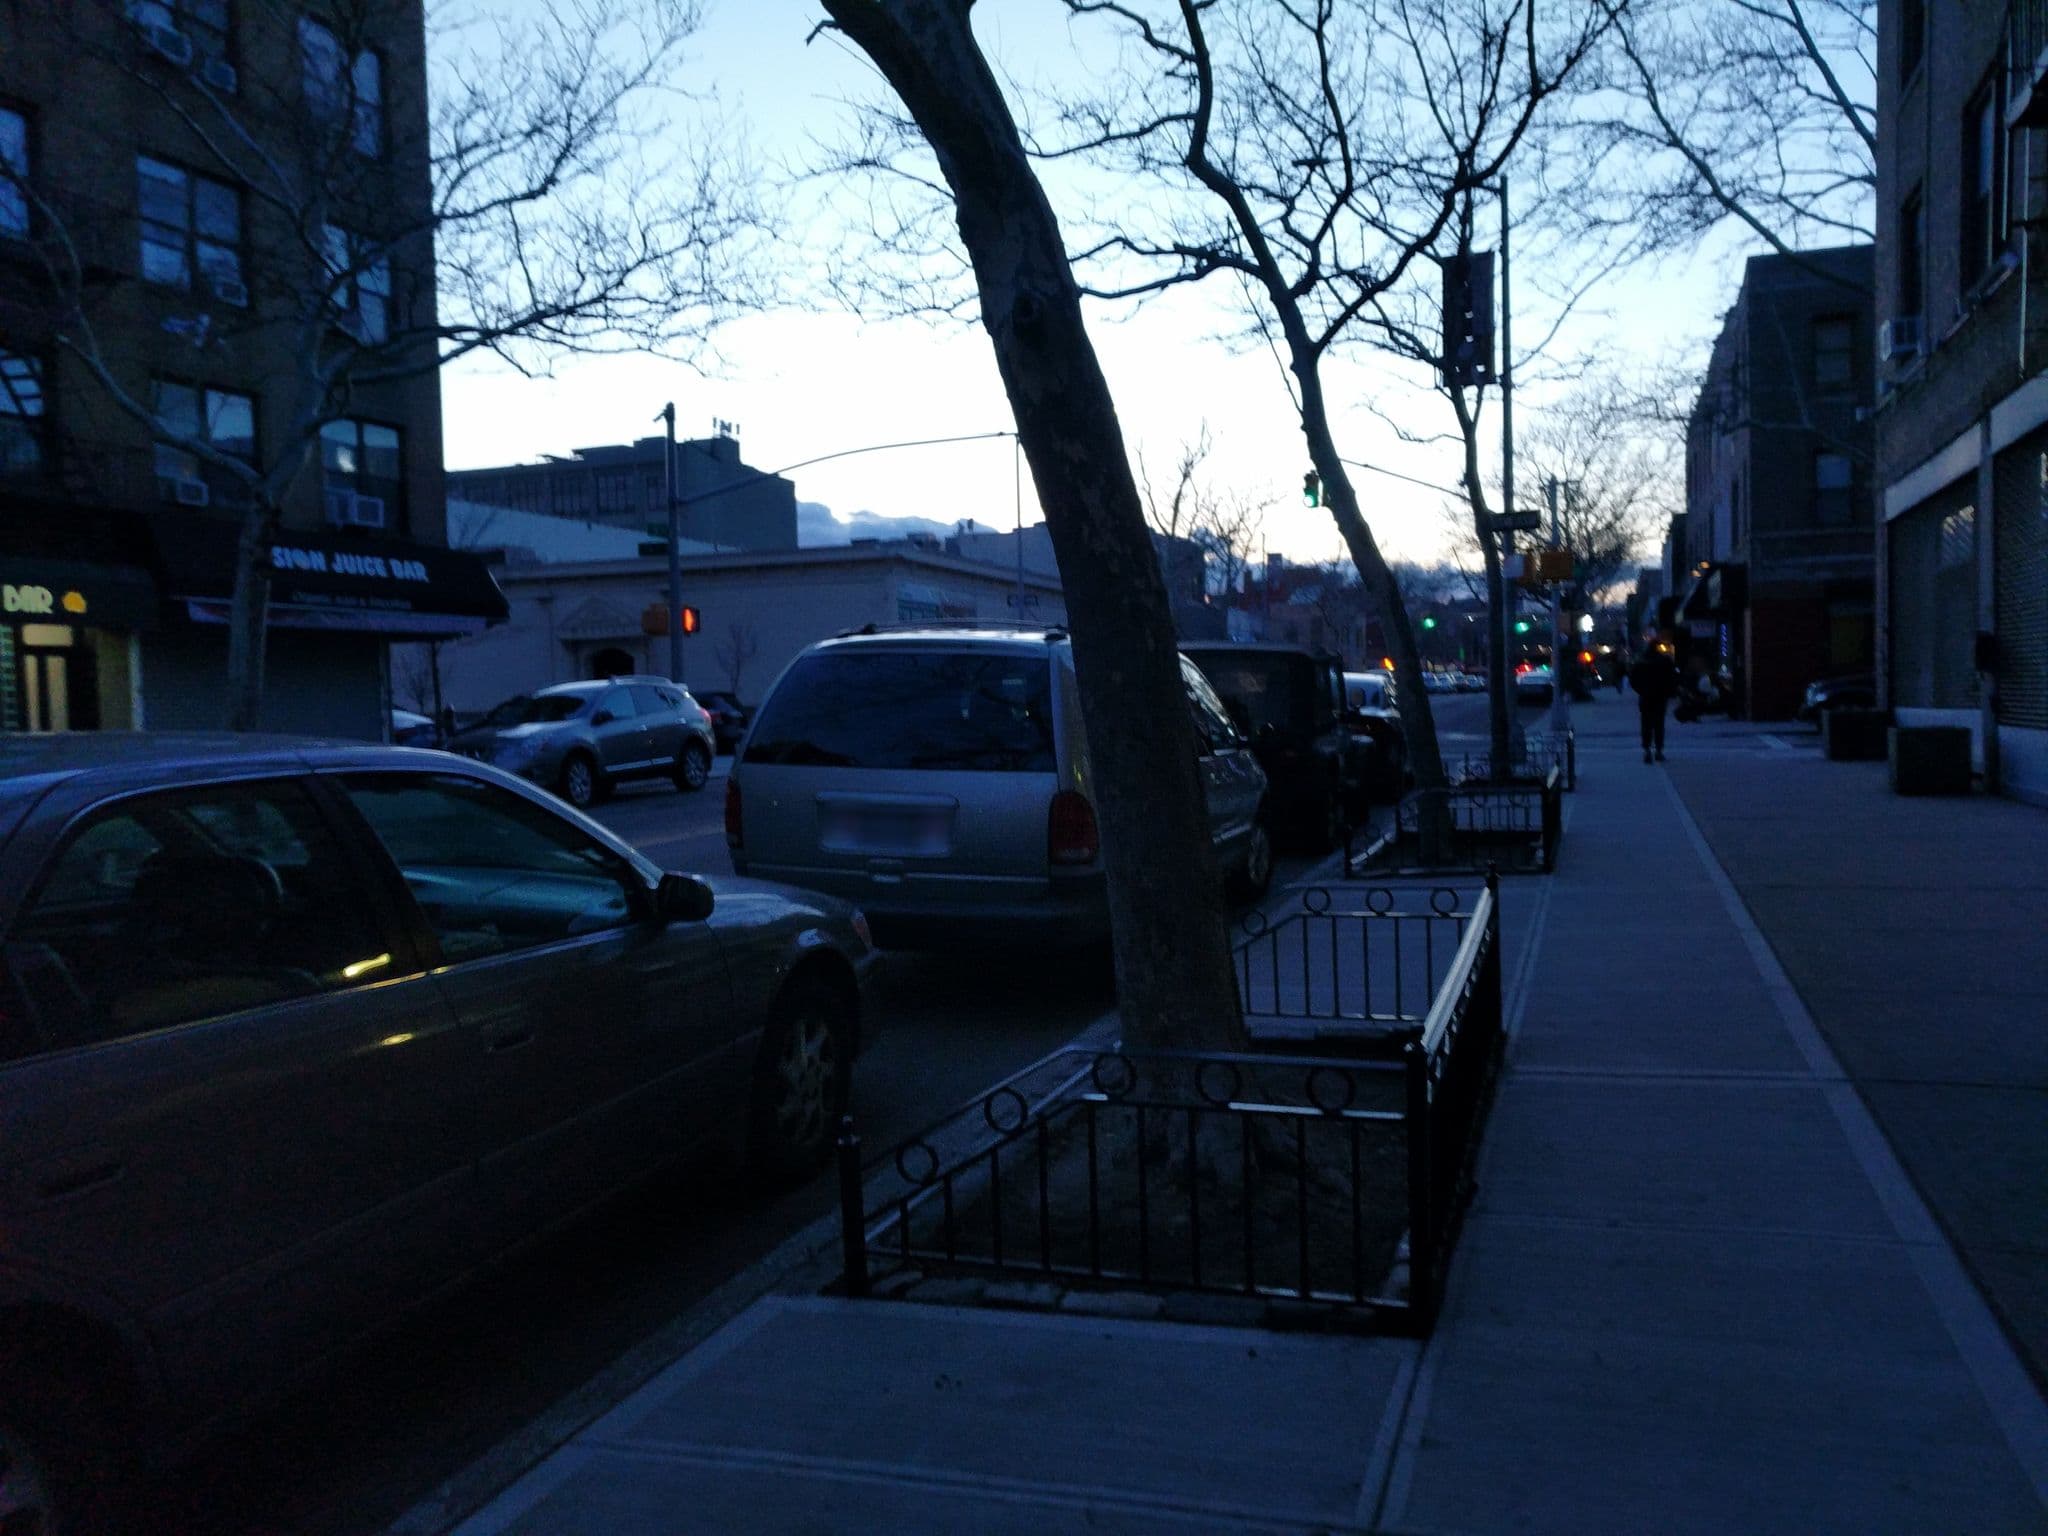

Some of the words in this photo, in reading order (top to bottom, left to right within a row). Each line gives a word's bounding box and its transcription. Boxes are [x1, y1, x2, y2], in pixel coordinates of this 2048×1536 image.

[270, 545, 328, 573] SION
[331, 552, 388, 579] JUICE
[389, 558, 431, 584] BAR
